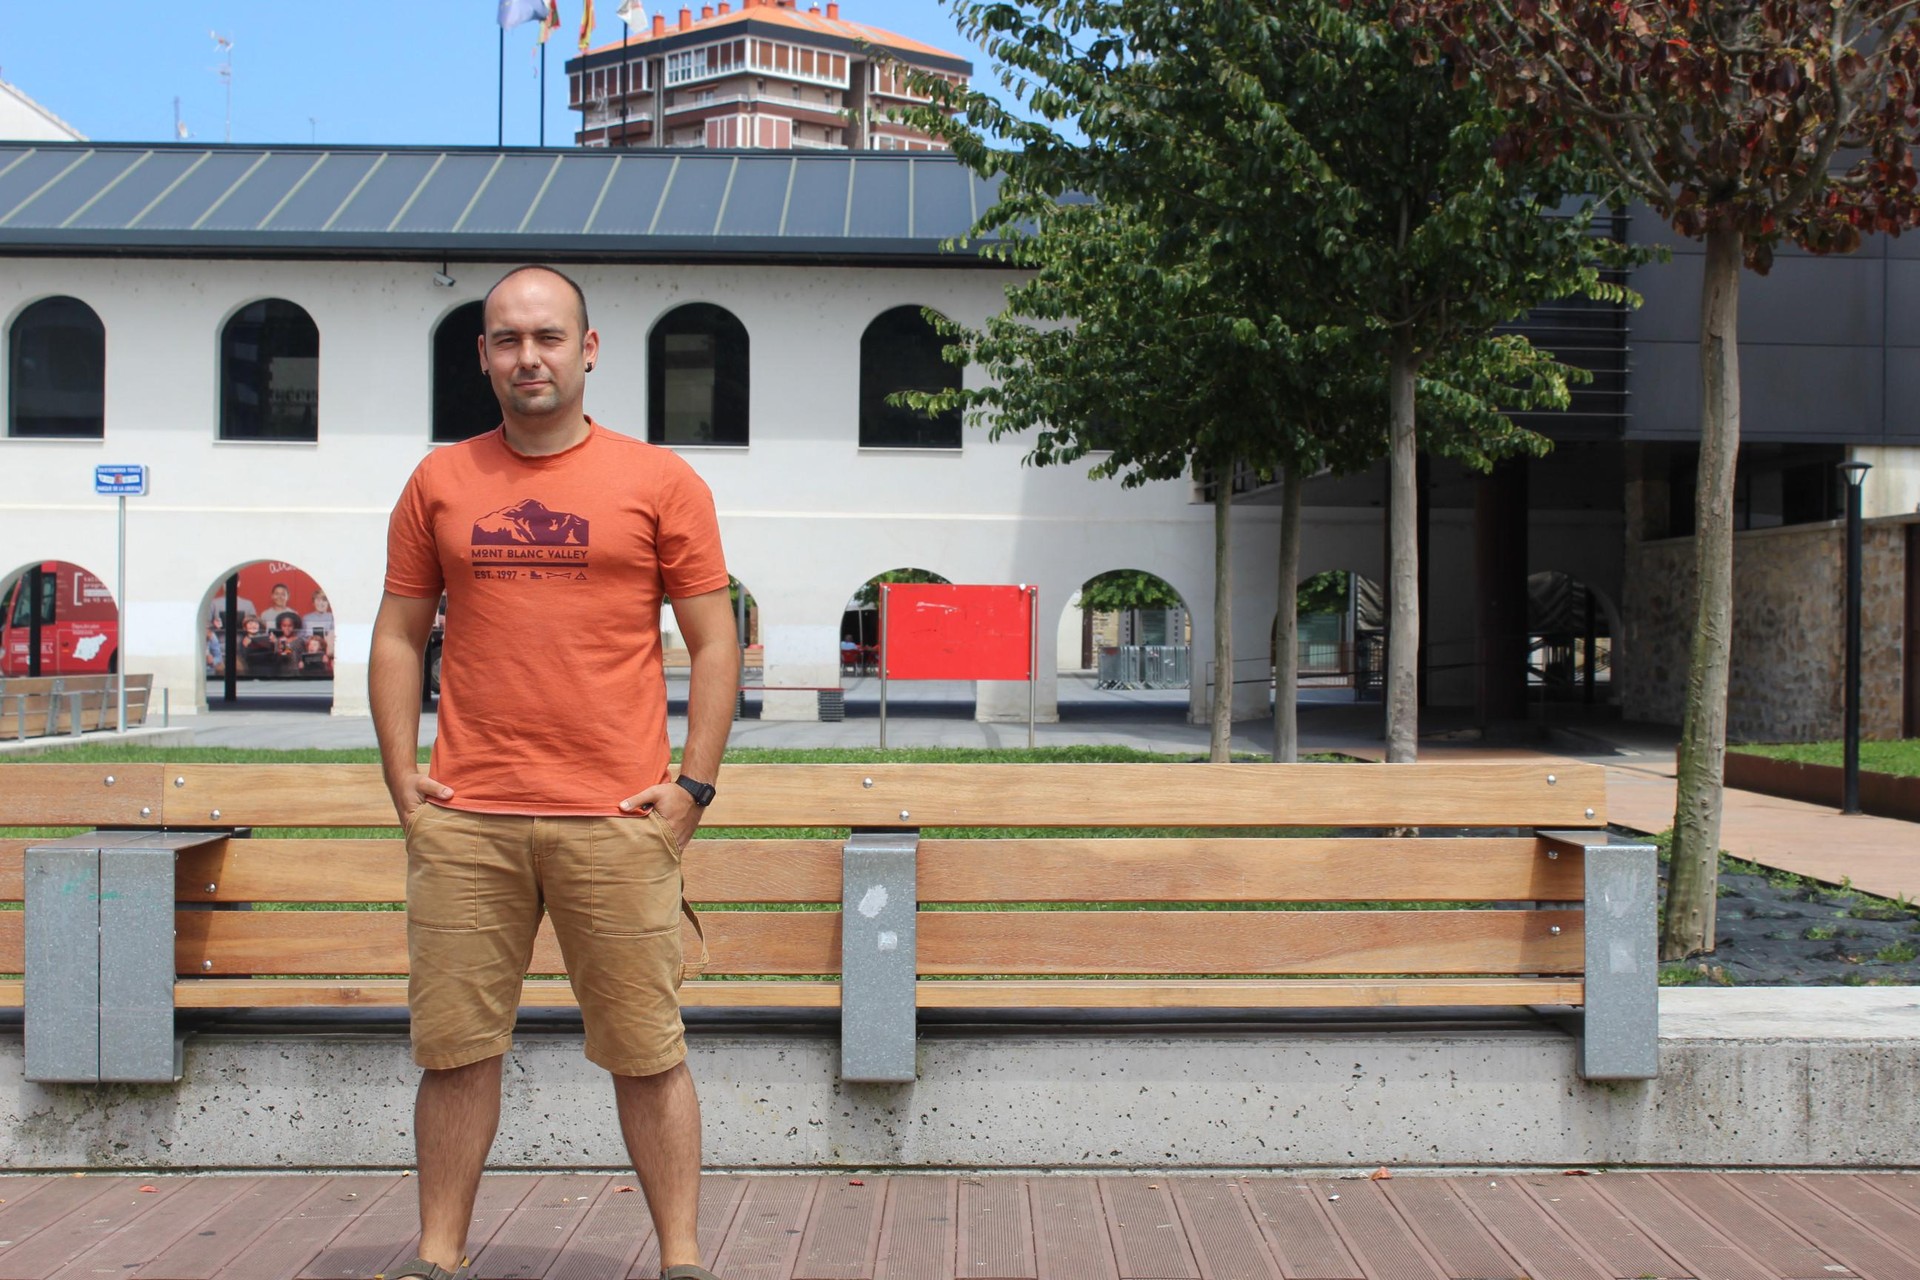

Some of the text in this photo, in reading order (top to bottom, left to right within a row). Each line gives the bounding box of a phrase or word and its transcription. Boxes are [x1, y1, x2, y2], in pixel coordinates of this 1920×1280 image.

[471, 549, 588, 559] MONT BLANC VALLEY
[474, 570, 494, 580] EST.
[496, 570, 517, 580] 1997
